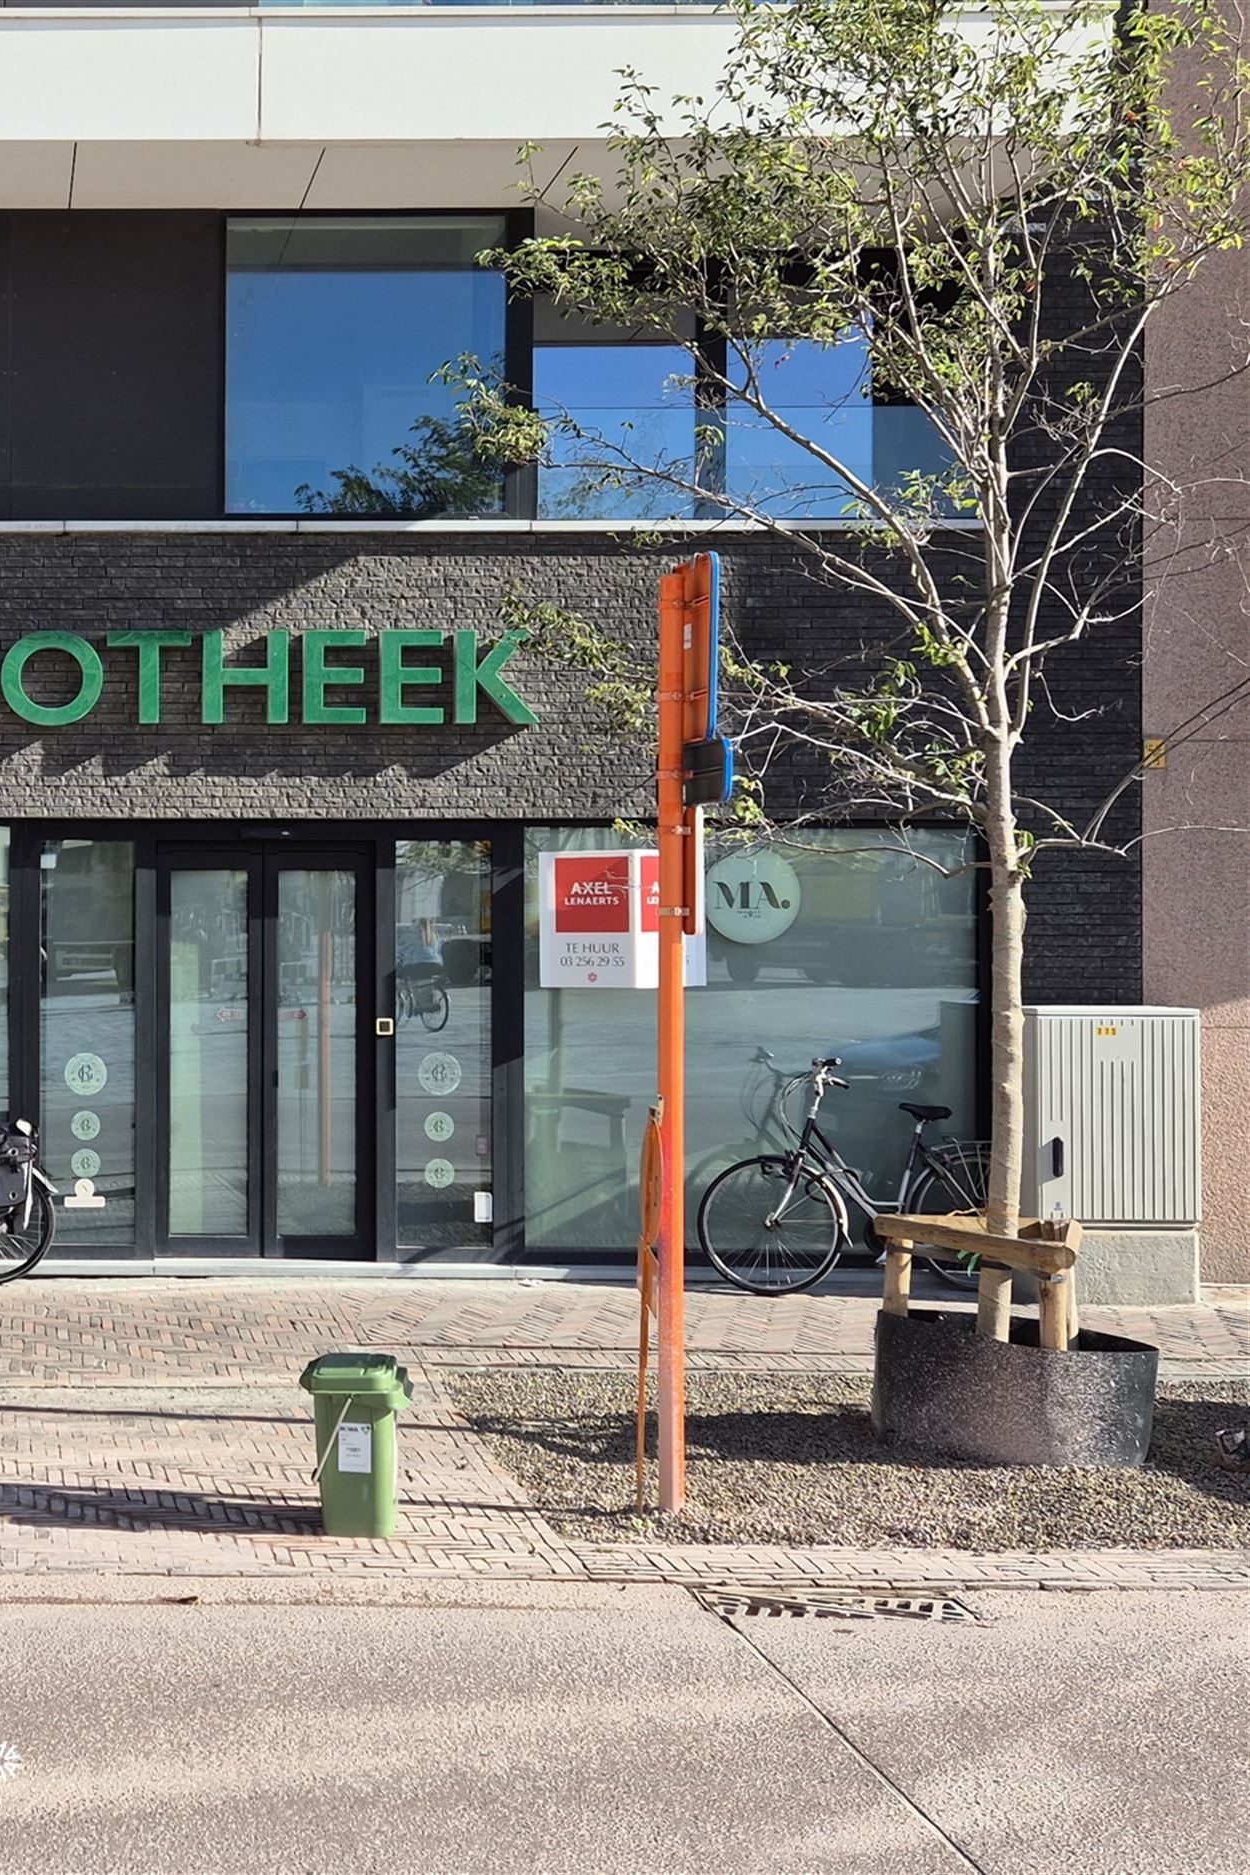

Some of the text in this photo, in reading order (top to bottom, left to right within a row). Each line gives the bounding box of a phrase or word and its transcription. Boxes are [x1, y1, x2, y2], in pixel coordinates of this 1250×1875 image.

[571, 882, 612, 895] AXEL
[564, 896, 620, 906] LENAERTS
[565, 942, 620, 954] TE HUUR
[560, 956, 626, 967] 03 256 29 55
